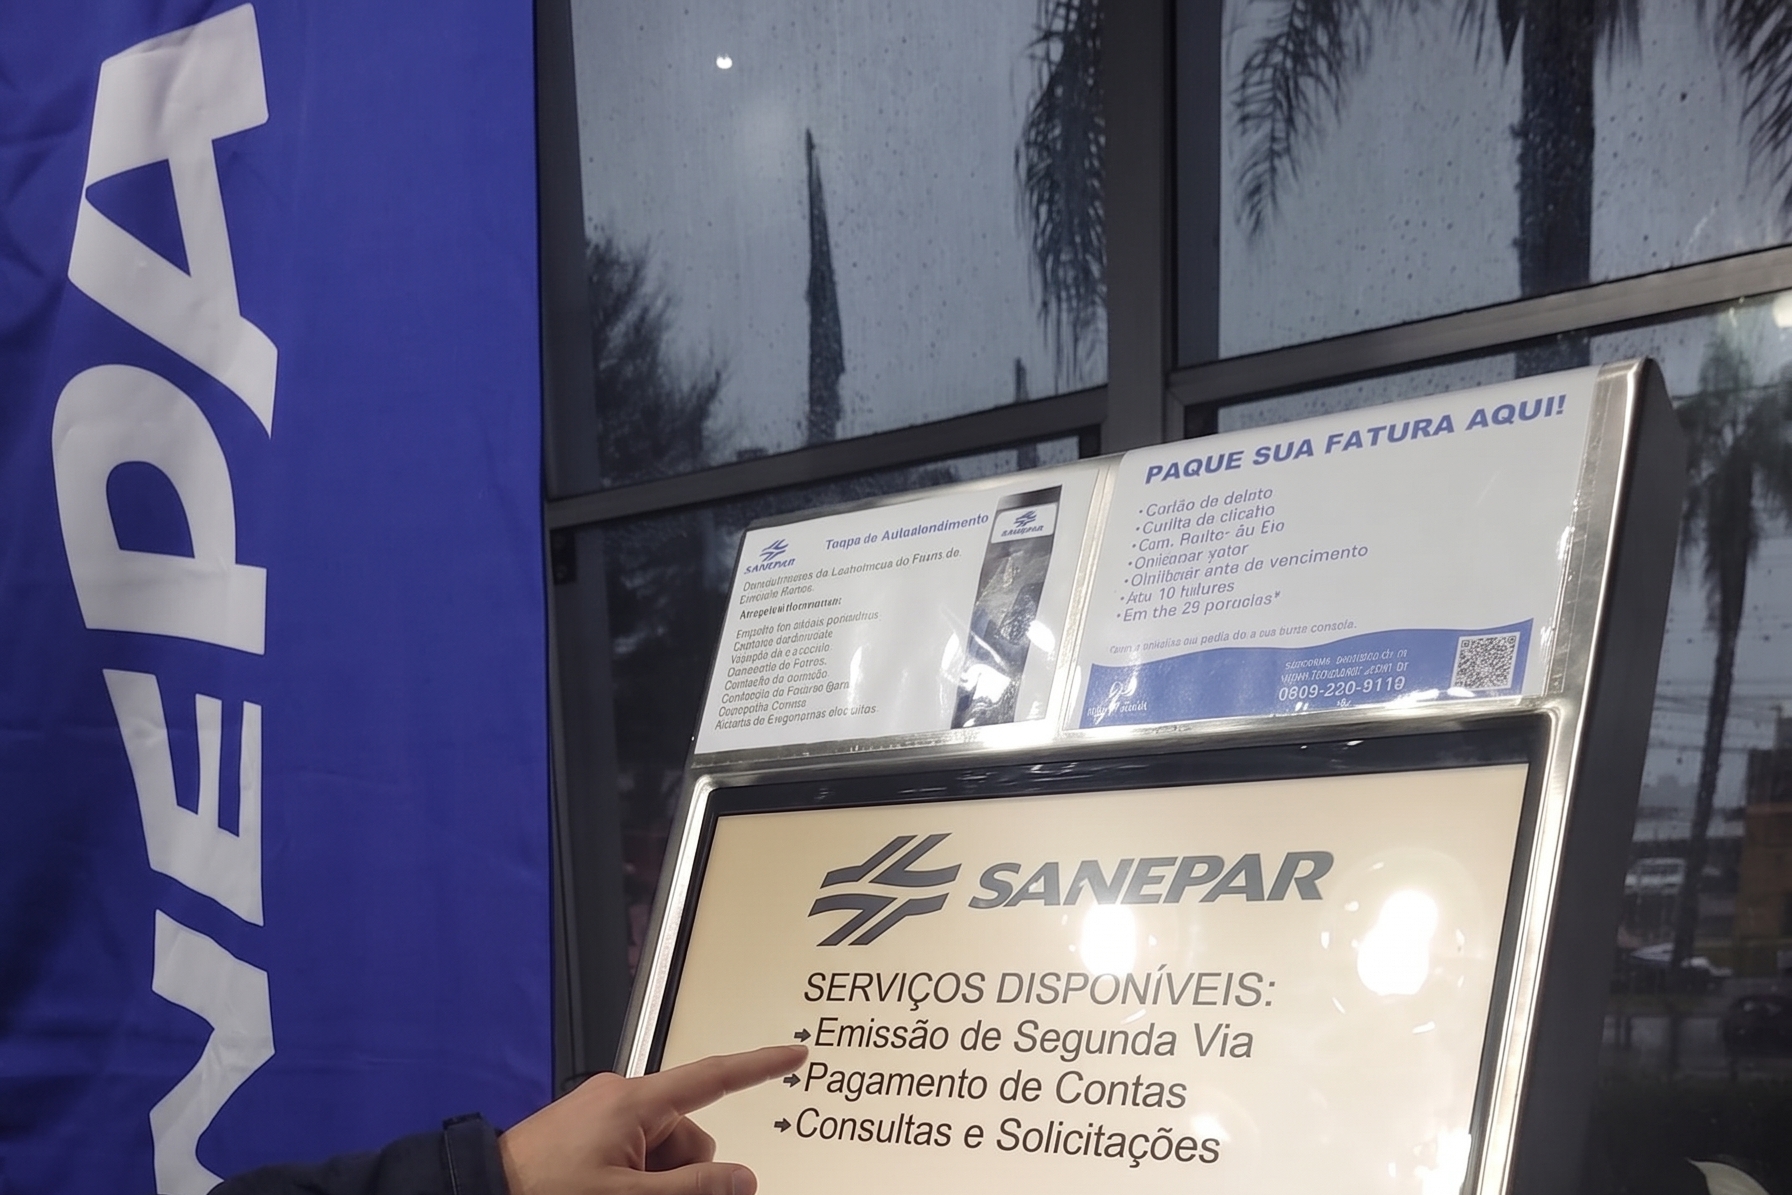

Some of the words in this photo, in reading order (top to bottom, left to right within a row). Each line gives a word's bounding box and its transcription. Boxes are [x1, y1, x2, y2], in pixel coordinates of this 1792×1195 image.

[1144, 450, 1244, 485] PAQUE
[1252, 438, 1314, 467] SUA
[1325, 414, 1455, 453] FATURA
[1465, 394, 1567, 431] AQUI!
[1199, 495, 1219, 510] de
[1244, 556, 1264, 573] de
[1270, 544, 1368, 569] vencimento
[1123, 607, 1147, 623] Em
[1159, 586, 1175, 601] 10
[968, 850, 1334, 909] SANEPAR
[803, 971, 986, 1012] SERVIÇOS
[996, 963, 1276, 1007] DISPONÍVEIS:
[814, 1016, 949, 1051] Emissão
[960, 1019, 1002, 1052] de
[1013, 1019, 1178, 1063] Segunda
[1193, 1022, 1254, 1059] Via
[803, 1061, 988, 1103] Pagamento
[999, 1068, 1043, 1102] de
[1055, 1070, 1188, 1109] Contas
[795, 1107, 953, 1148] Consultas
[963, 1122, 984, 1149] e
[996, 1117, 1221, 1169] Solicitações
